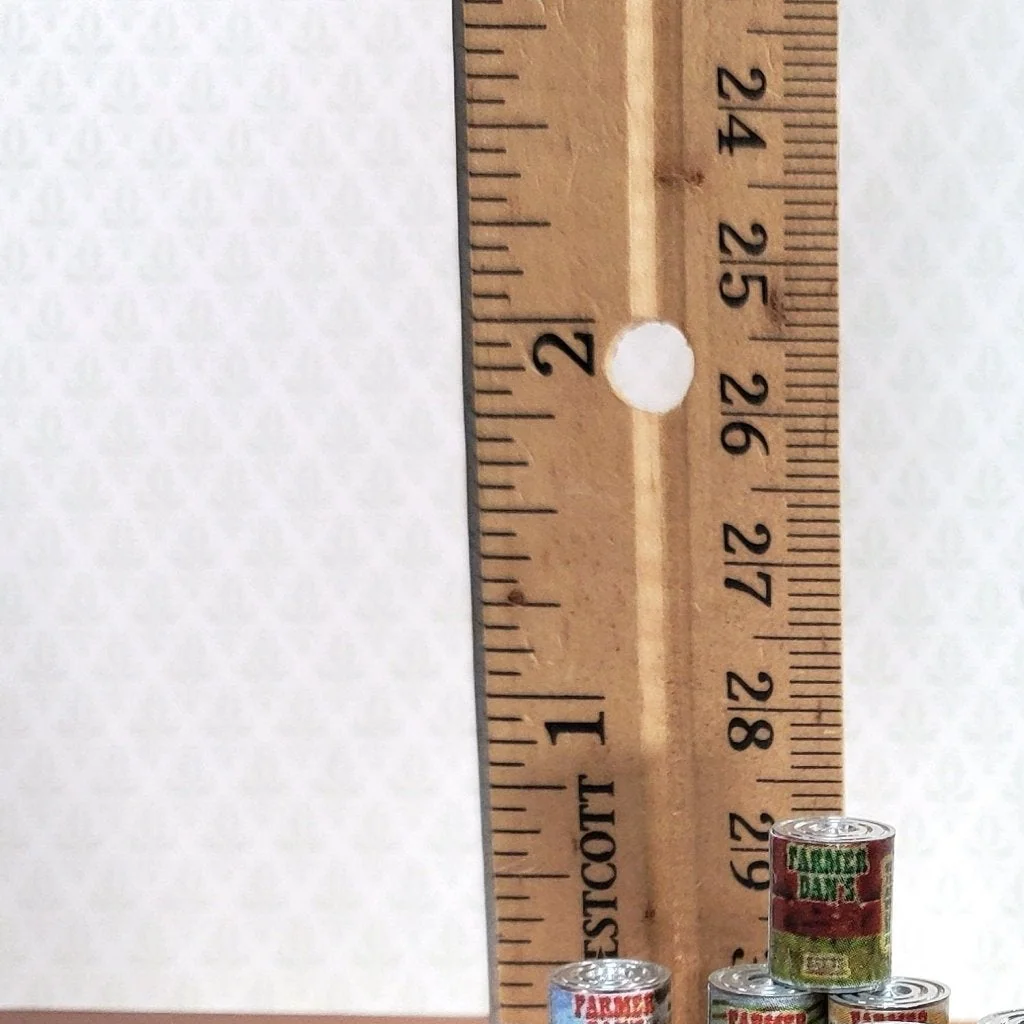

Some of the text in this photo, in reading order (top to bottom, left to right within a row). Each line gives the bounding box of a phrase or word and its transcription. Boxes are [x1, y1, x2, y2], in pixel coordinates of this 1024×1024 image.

[716, 66, 767, 156] 24
[718, 222, 769, 308] 25
[531, 331, 596, 377] 2
[719, 373, 769, 457] 26
[722, 522, 773, 608] 27
[544, 711, 606, 746] 1
[726, 671, 775, 751] 28
[578, 775, 619, 959] ESTCOTT
